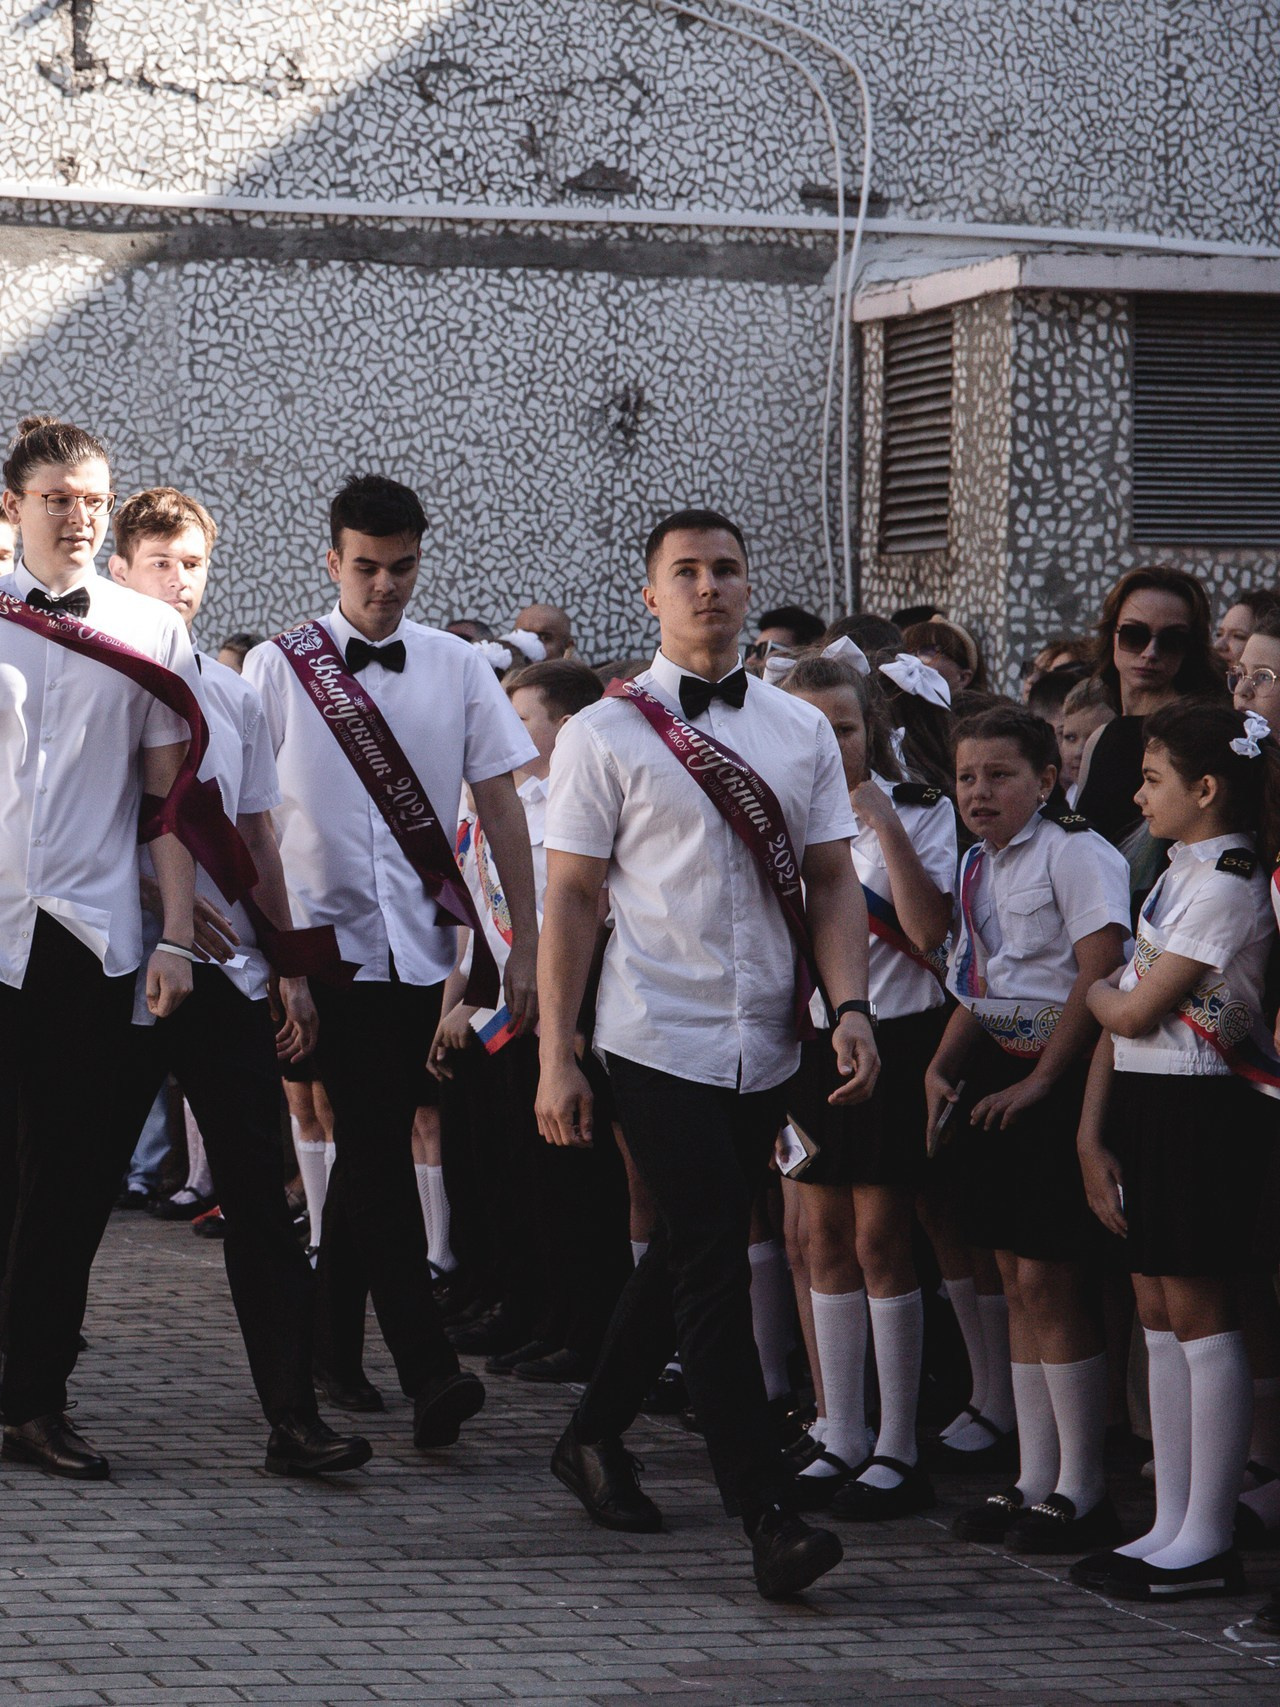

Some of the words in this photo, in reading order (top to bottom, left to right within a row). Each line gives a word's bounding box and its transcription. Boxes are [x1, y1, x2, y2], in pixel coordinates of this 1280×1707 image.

[47, 619, 74, 633] МАОУ
[308, 680, 328, 702] МАОУ
[308, 654, 392, 778] Выпускник
[383, 777, 435, 832] 2024
[665, 728, 690, 752] МАОУ
[766, 833, 799, 896] 2024
